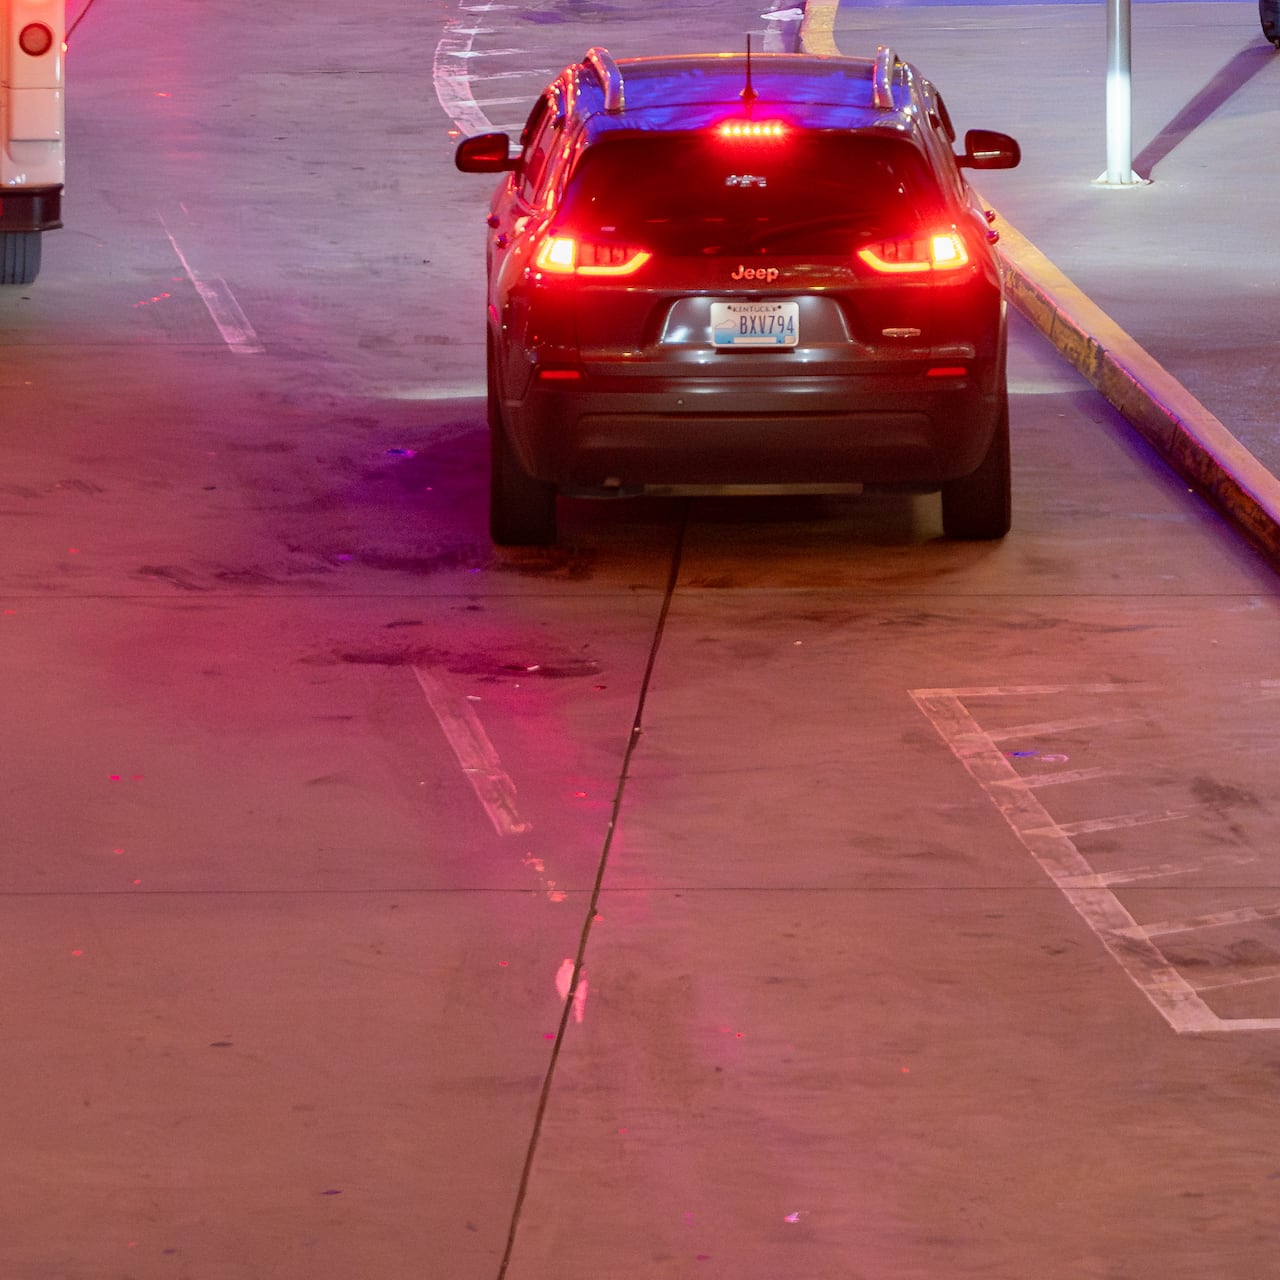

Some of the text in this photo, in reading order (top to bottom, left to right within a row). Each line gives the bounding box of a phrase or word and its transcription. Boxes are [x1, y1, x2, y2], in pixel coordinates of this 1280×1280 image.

[731, 265, 779, 283] Jeep
[733, 305, 777, 313] KENTUCKY
[740, 315, 794, 335] BXV794
